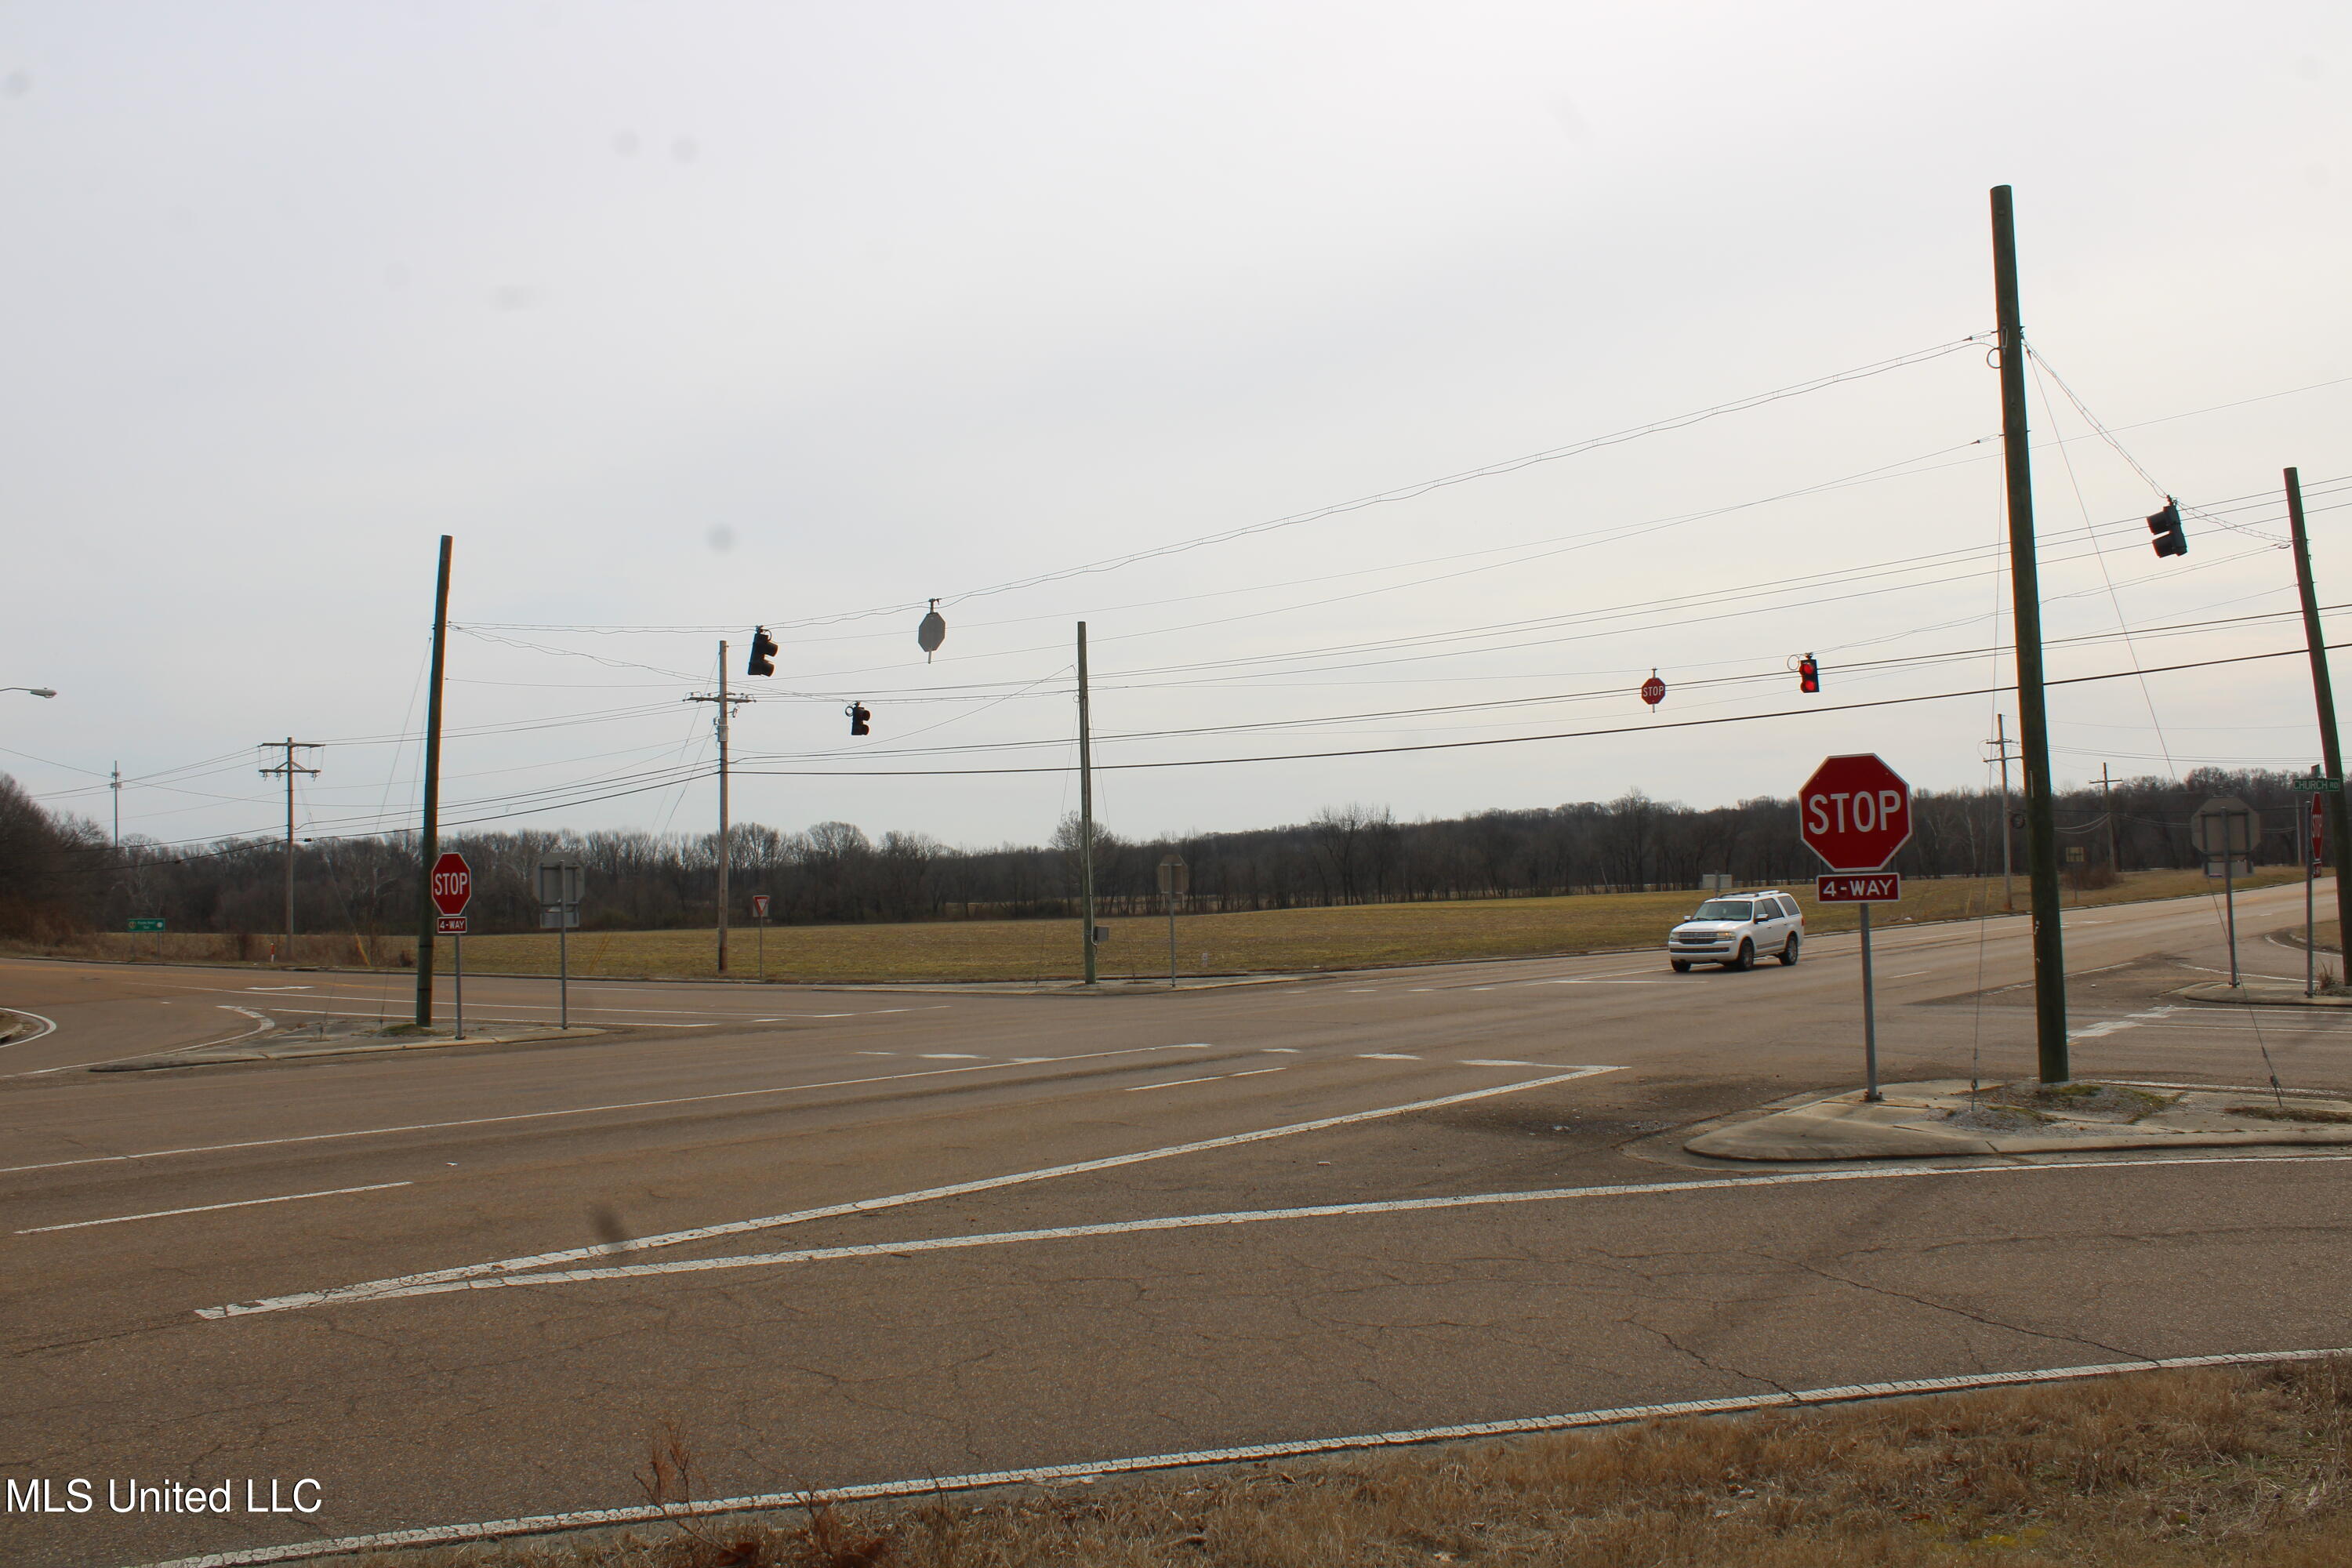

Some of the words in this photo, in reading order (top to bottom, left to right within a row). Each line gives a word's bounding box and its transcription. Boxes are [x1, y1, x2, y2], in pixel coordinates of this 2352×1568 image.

[1642, 685, 1664, 697] STOP
[2293, 780, 2328, 790] CHURCH
[1808, 789, 1901, 835] STOP
[434, 872, 468, 896] STOP
[1823, 879, 1893, 897] 4-WAY
[440, 920, 465, 930] 4-WAY
